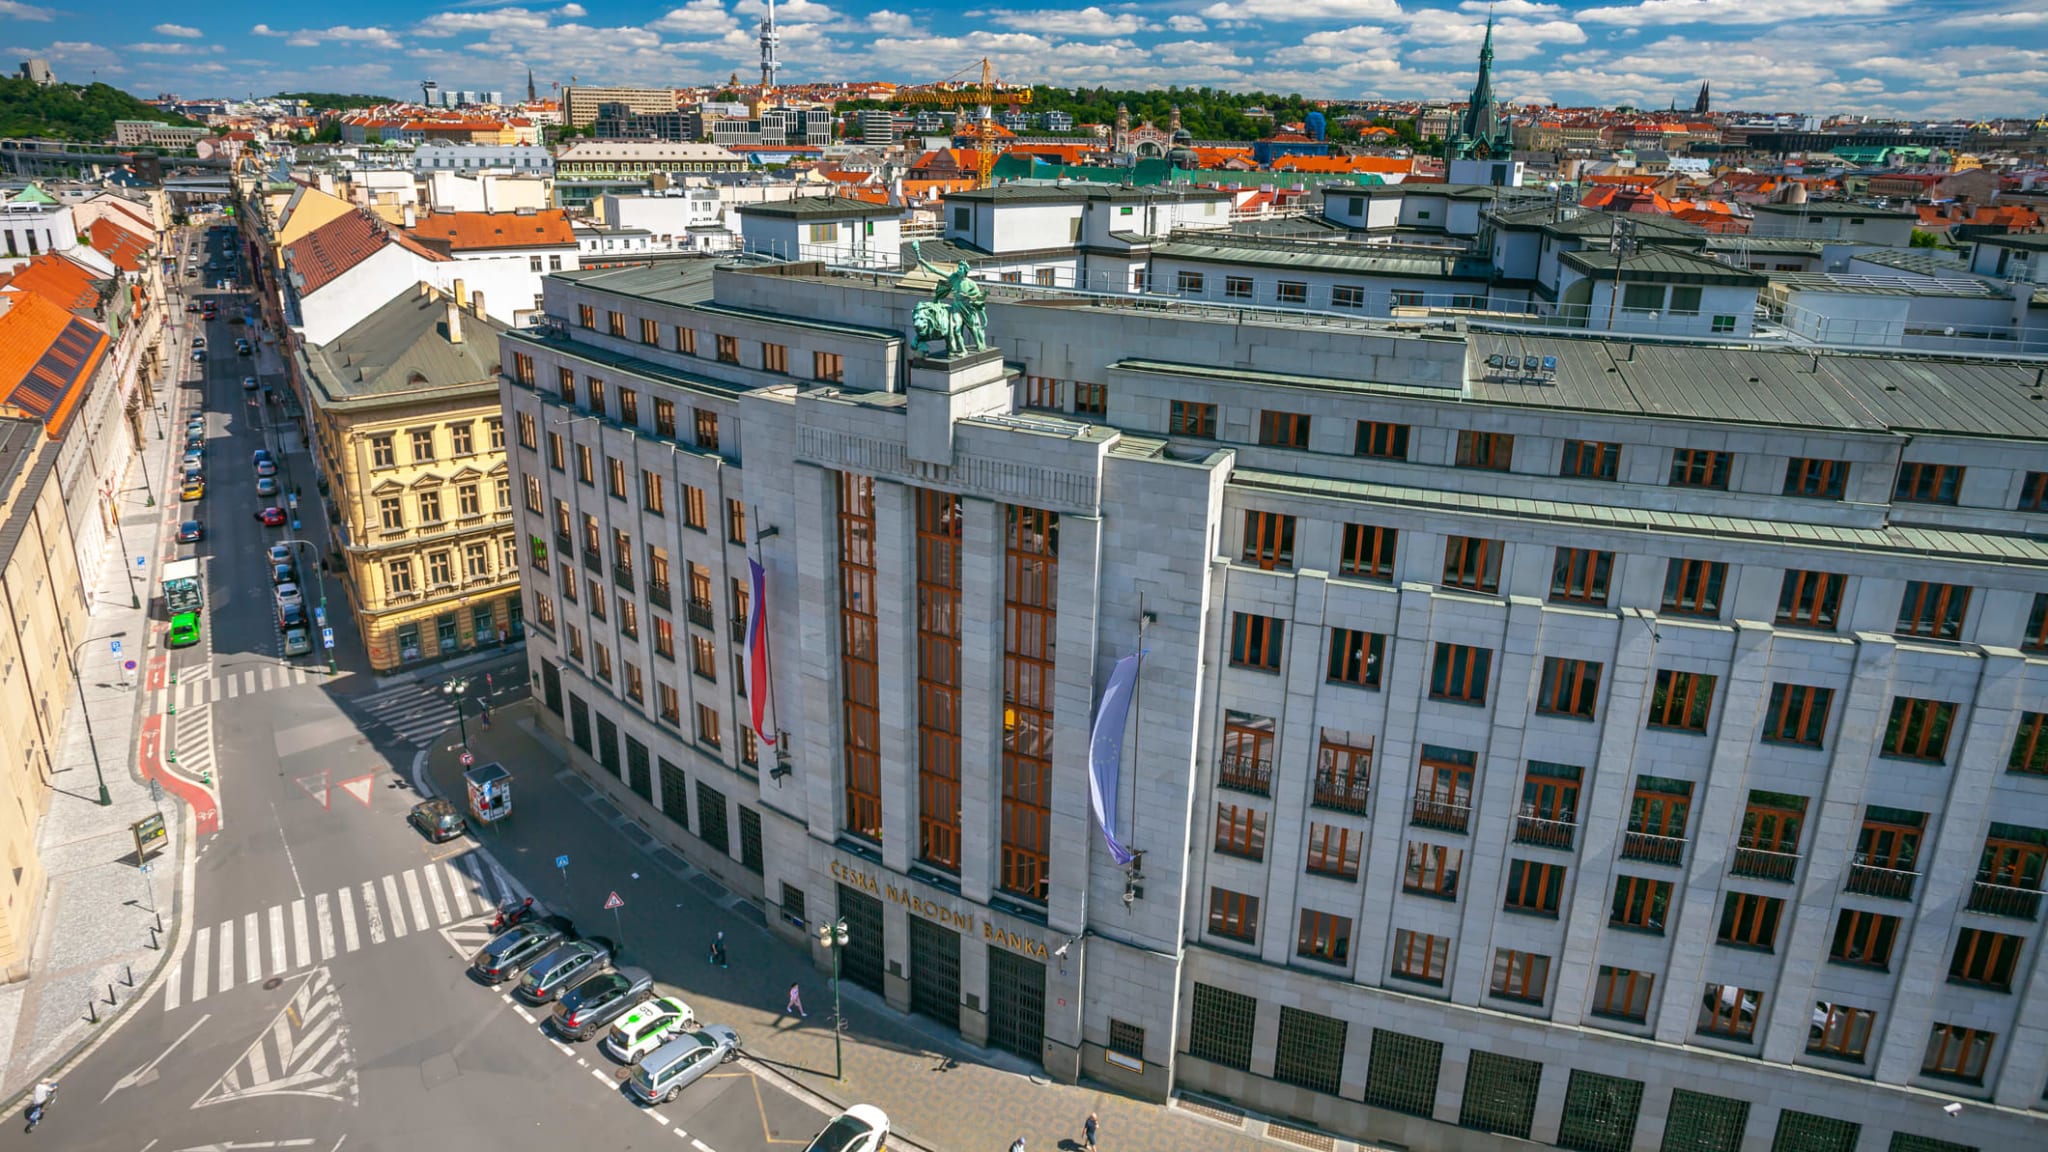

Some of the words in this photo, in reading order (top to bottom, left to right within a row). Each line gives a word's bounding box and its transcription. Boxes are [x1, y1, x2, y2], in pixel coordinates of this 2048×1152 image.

[830, 860, 879, 895] ČESKÁ
[887, 885, 973, 932] NÁRODNÍ
[983, 922, 1049, 959] BANKA
